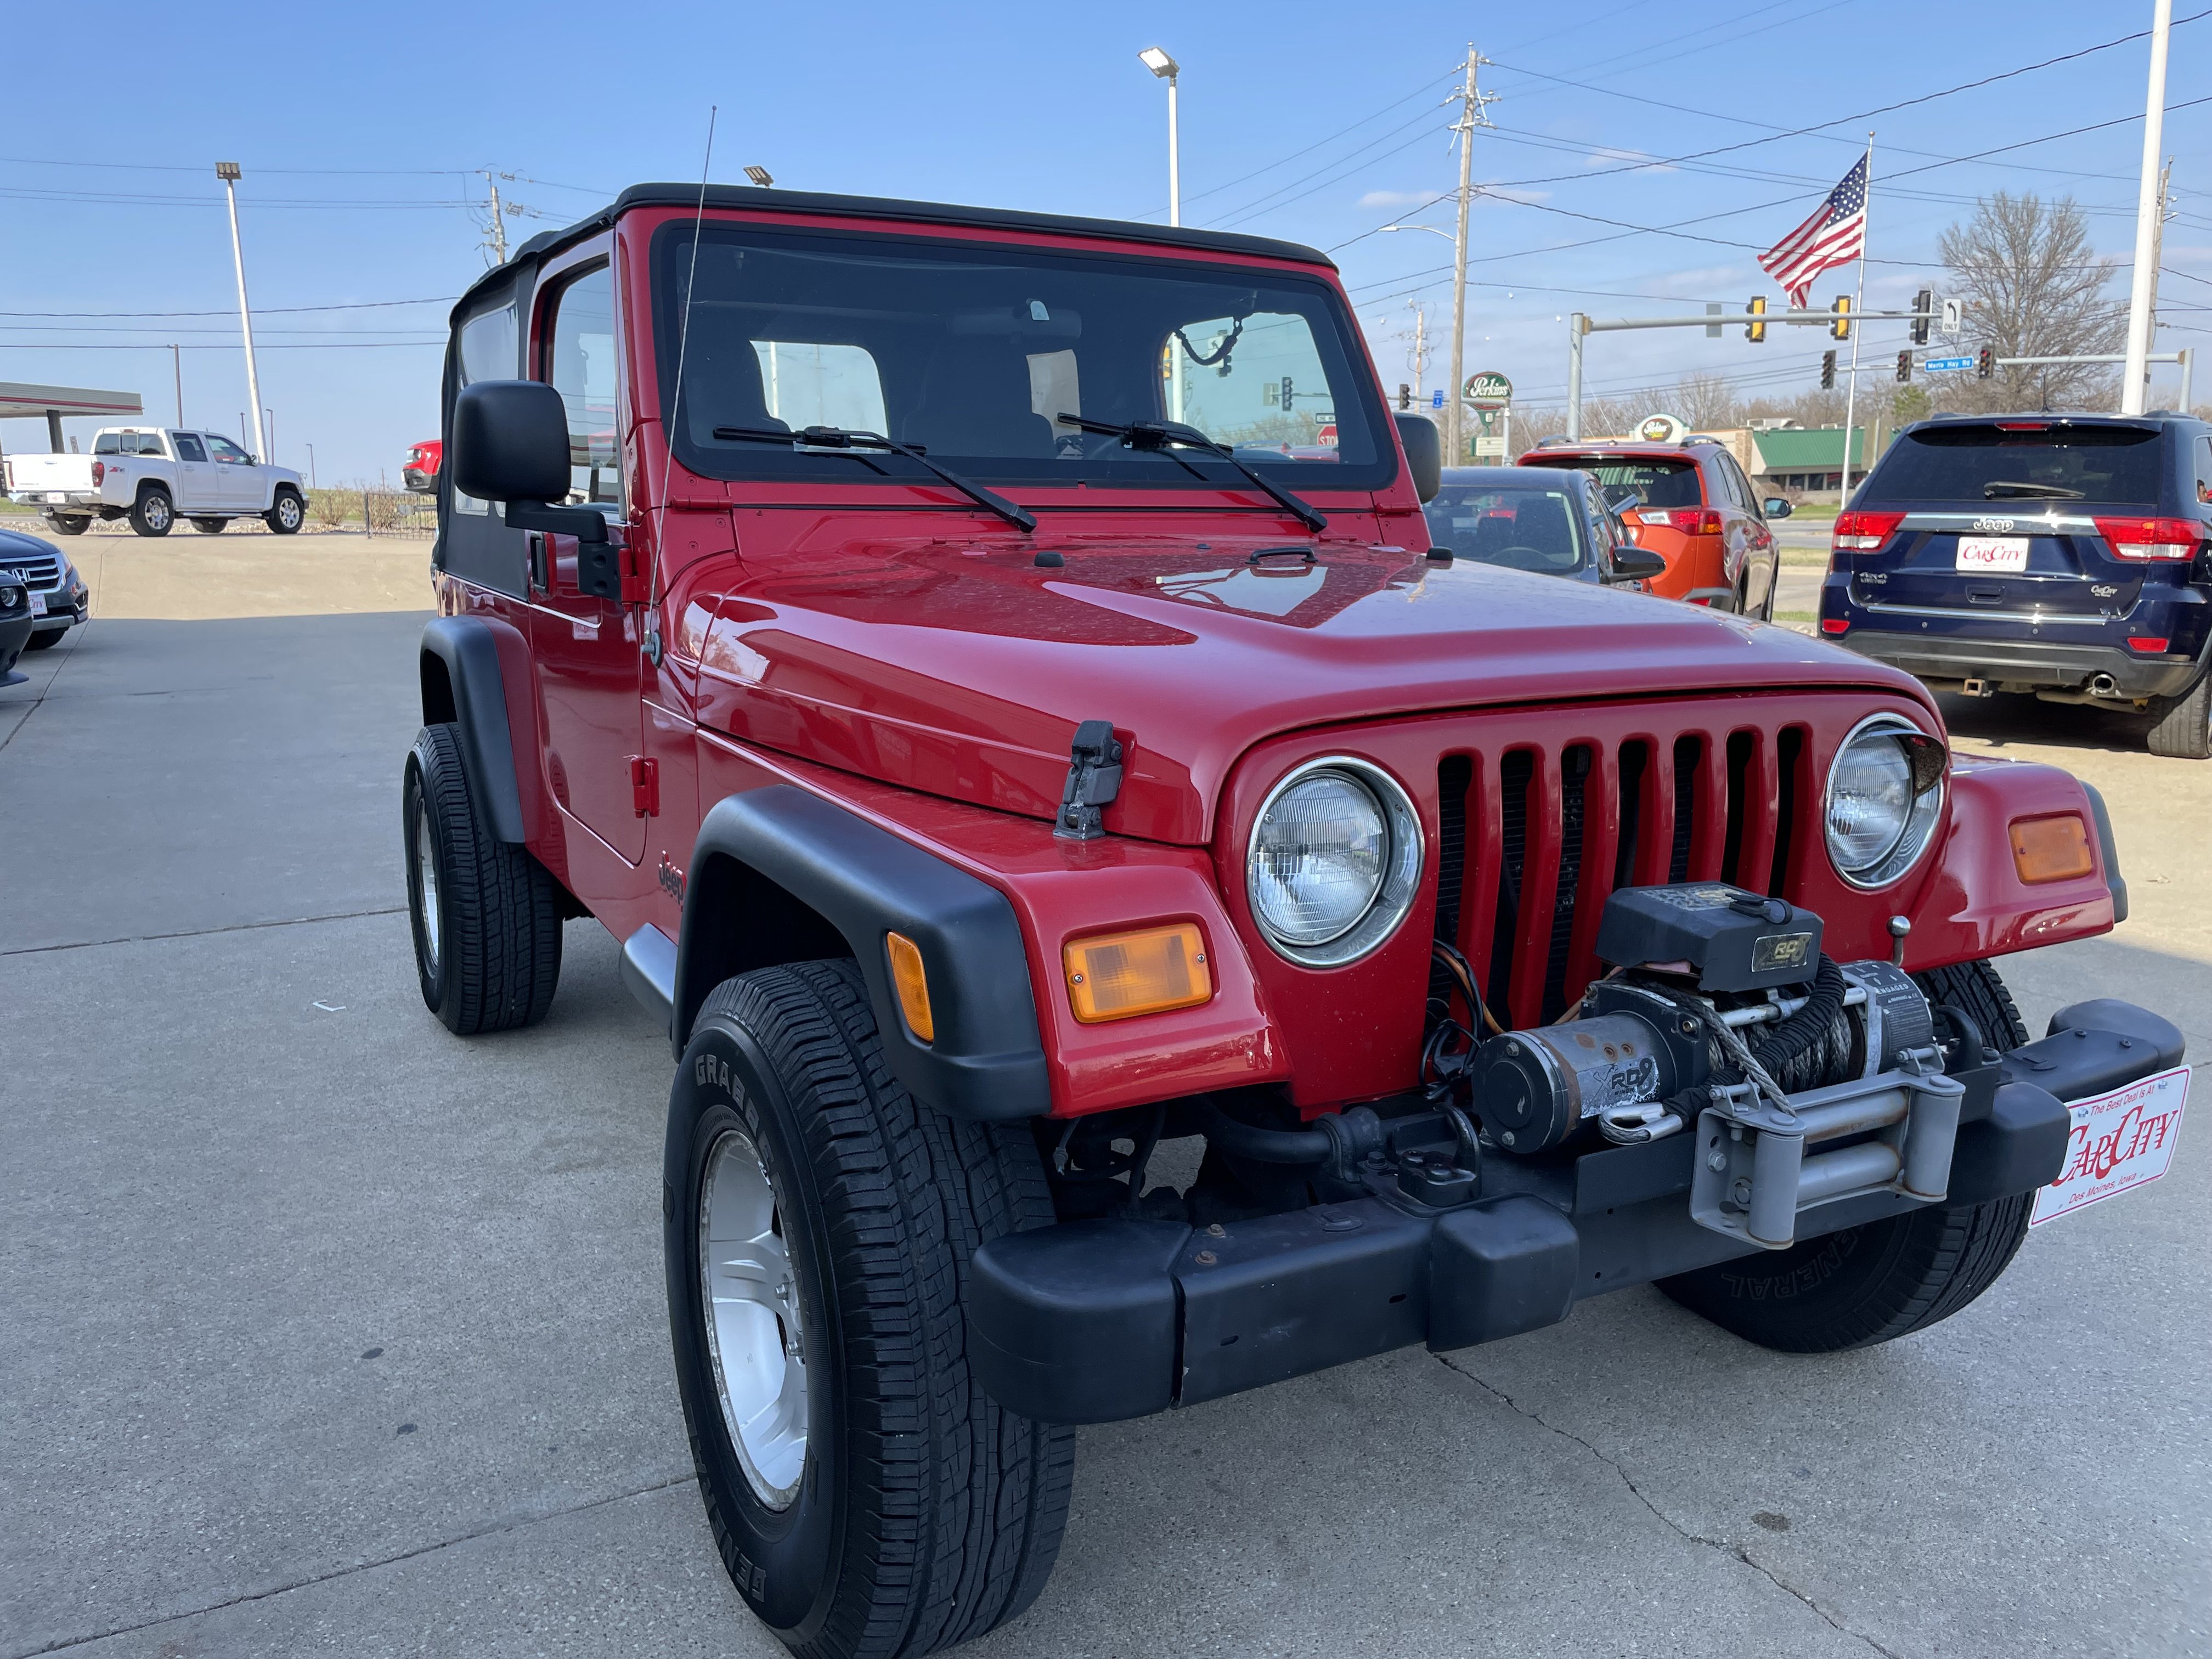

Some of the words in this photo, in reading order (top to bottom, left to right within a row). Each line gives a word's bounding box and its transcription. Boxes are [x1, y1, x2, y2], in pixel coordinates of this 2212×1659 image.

[1470, 376, 1509, 397] Perkins
[1973, 517, 2014, 533] Jeep
[659, 850, 687, 906] Jeep
[1877, 983, 1910, 995] ENGAGED
[2090, 1105, 2104, 1116] The
[2106, 1098, 2123, 1111] Best
[2123, 1089, 2138, 1105] Deal
[2139, 1088, 2147, 1098] Is
[2146, 1085, 2155, 1095] At
[695, 1053, 788, 1212] GRABBER
[2069, 1192, 2085, 1204] Des
[2086, 1180, 2116, 1197] Moines,
[2118, 1172, 2137, 1185] Iowa
[1720, 1228, 1860, 1300] ENERAL
